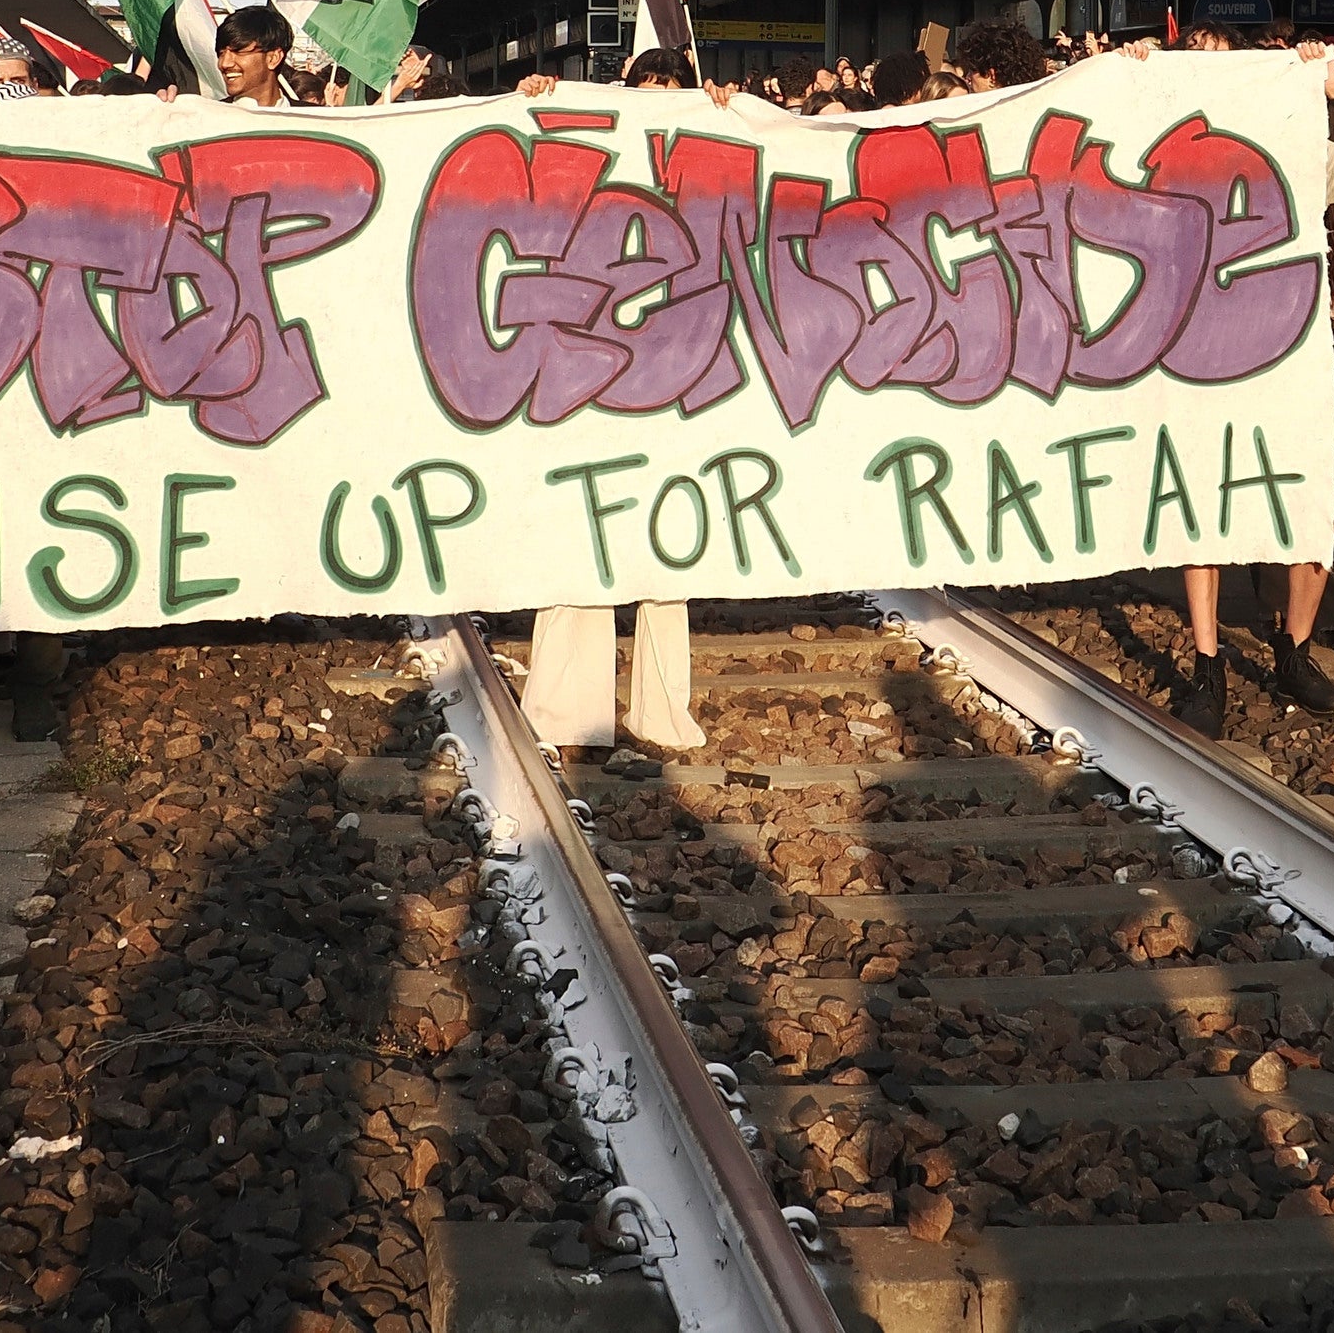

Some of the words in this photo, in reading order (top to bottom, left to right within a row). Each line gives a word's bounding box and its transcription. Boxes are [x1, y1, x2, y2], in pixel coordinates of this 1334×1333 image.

[1208, 3, 1256, 16] SOUVENIR
[320, 460, 486, 594] UP
[545, 446, 802, 589] FOR
[864, 423, 1305, 568] RAFAH
